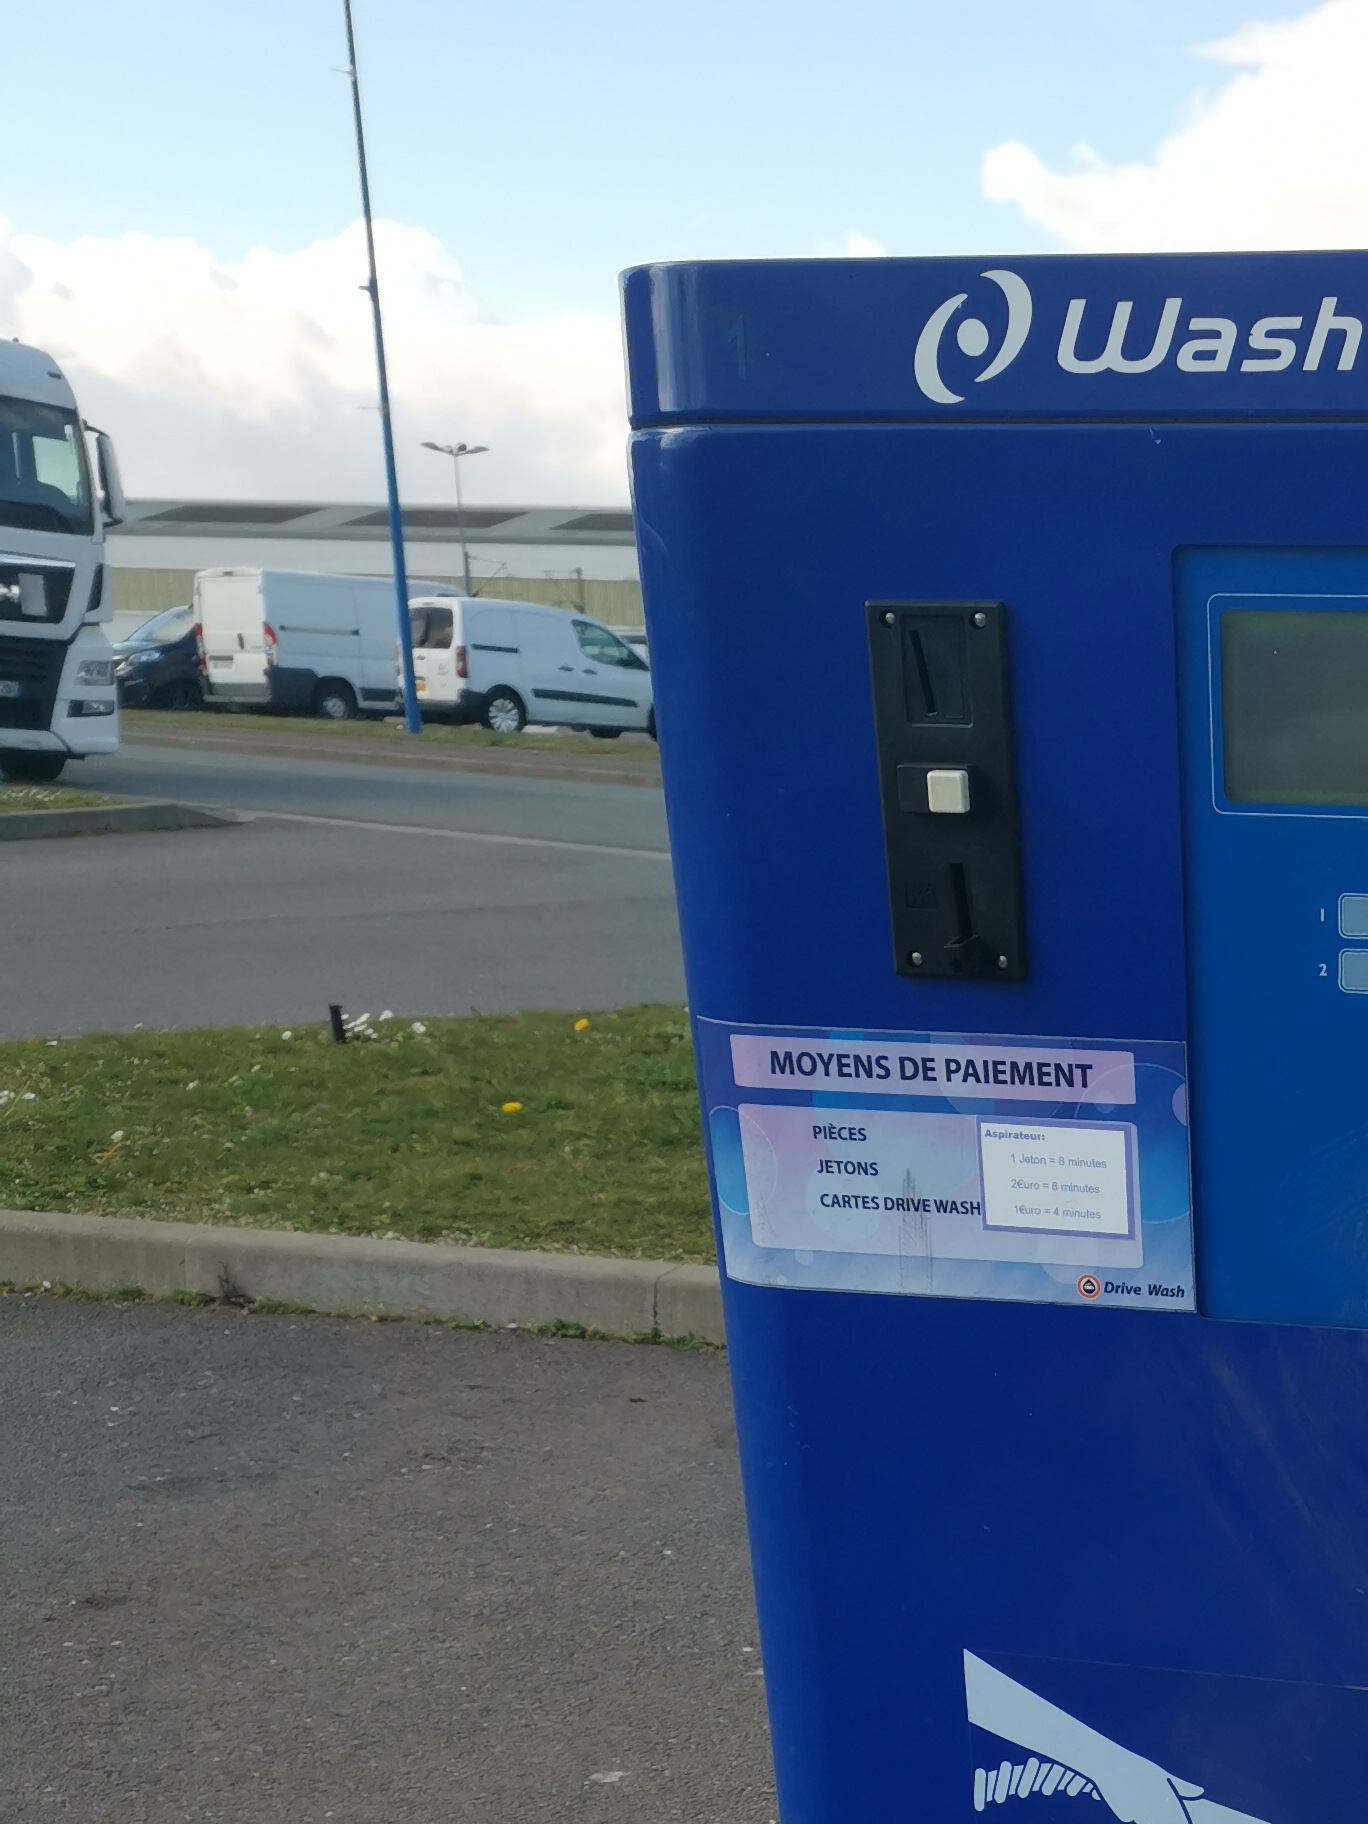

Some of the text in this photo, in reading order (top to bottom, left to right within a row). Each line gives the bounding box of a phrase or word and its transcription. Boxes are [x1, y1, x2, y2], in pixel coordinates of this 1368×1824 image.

[1317, 962, 1328, 977] 2
[769, 1050, 1094, 1089] MOYENS DE PAIEMENT
[812, 1122, 868, 1142] PIÈCES
[984, 1128, 1046, 1142] Aspirateur:
[816, 1158, 879, 1177] JETONS
[1010, 1153, 1016, 1164] 1
[1019, 1153, 1047, 1166] Jeton
[1058, 1155, 1065, 1167] 8
[1068, 1156, 1108, 1169] minutes
[1051, 1181, 1058, 1192] 8
[1060, 1183, 1101, 1194] minutes
[819, 1193, 982, 1216] CARTES DRIVE WASH
[1053, 1206, 1060, 1217] 4
[1062, 1207, 1102, 1219] minutes
[1103, 1280, 1185, 1298] Drive Wash
